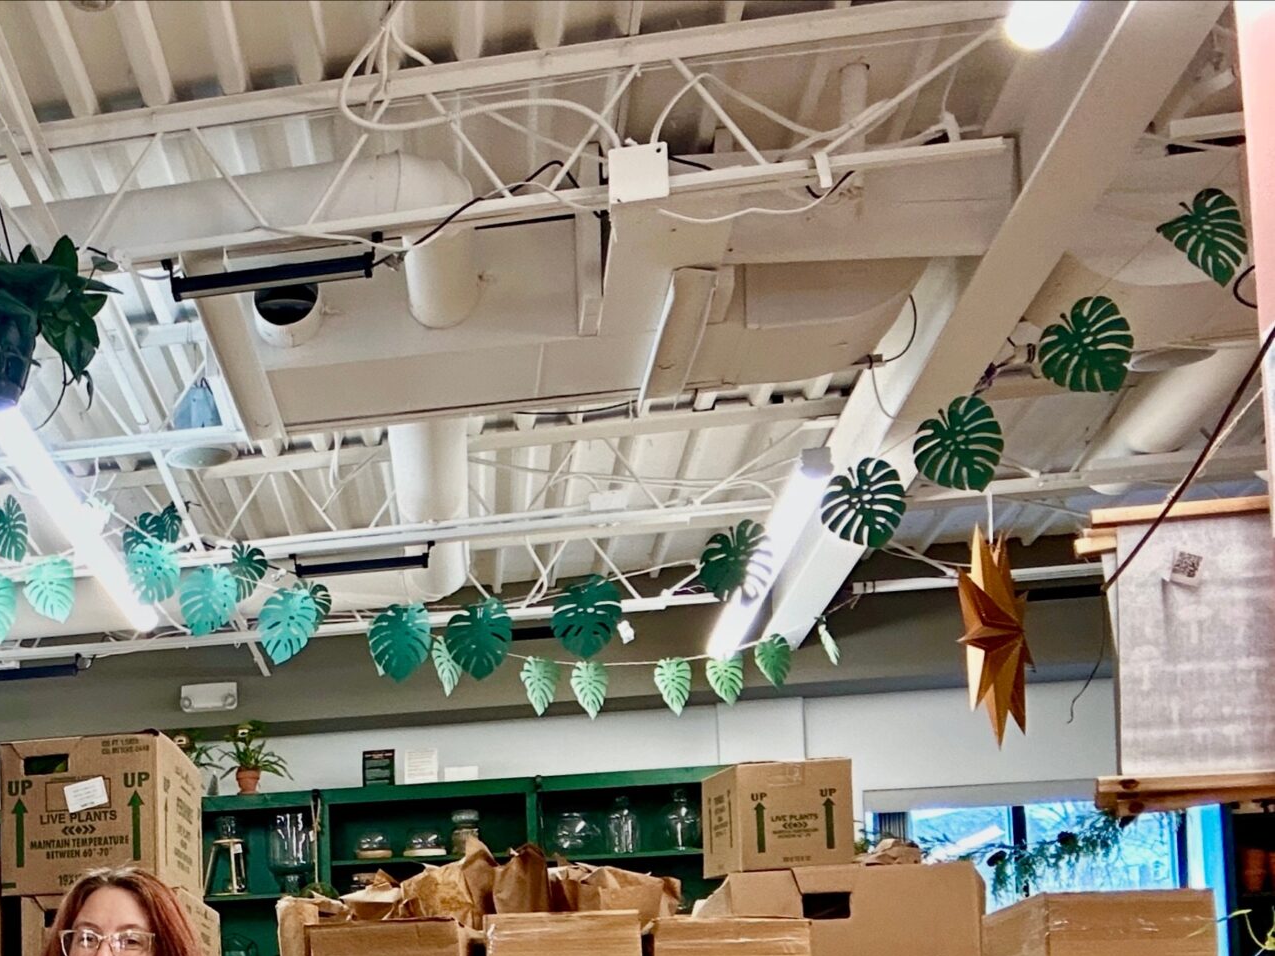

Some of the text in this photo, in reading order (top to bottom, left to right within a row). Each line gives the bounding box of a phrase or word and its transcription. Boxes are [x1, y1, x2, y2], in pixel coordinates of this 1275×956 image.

[123, 771, 150, 788] UP
[8, 778, 33, 796] UP
[819, 788, 837, 797] UP
[751, 792, 767, 802] UP
[39, 810, 118, 825] LIVE PLANTS
[789, 813, 819, 821] PLANTS
[29, 835, 130, 850] MAINTAIN TEMPERATURE
[45, 849, 81, 860] BETWEEN
